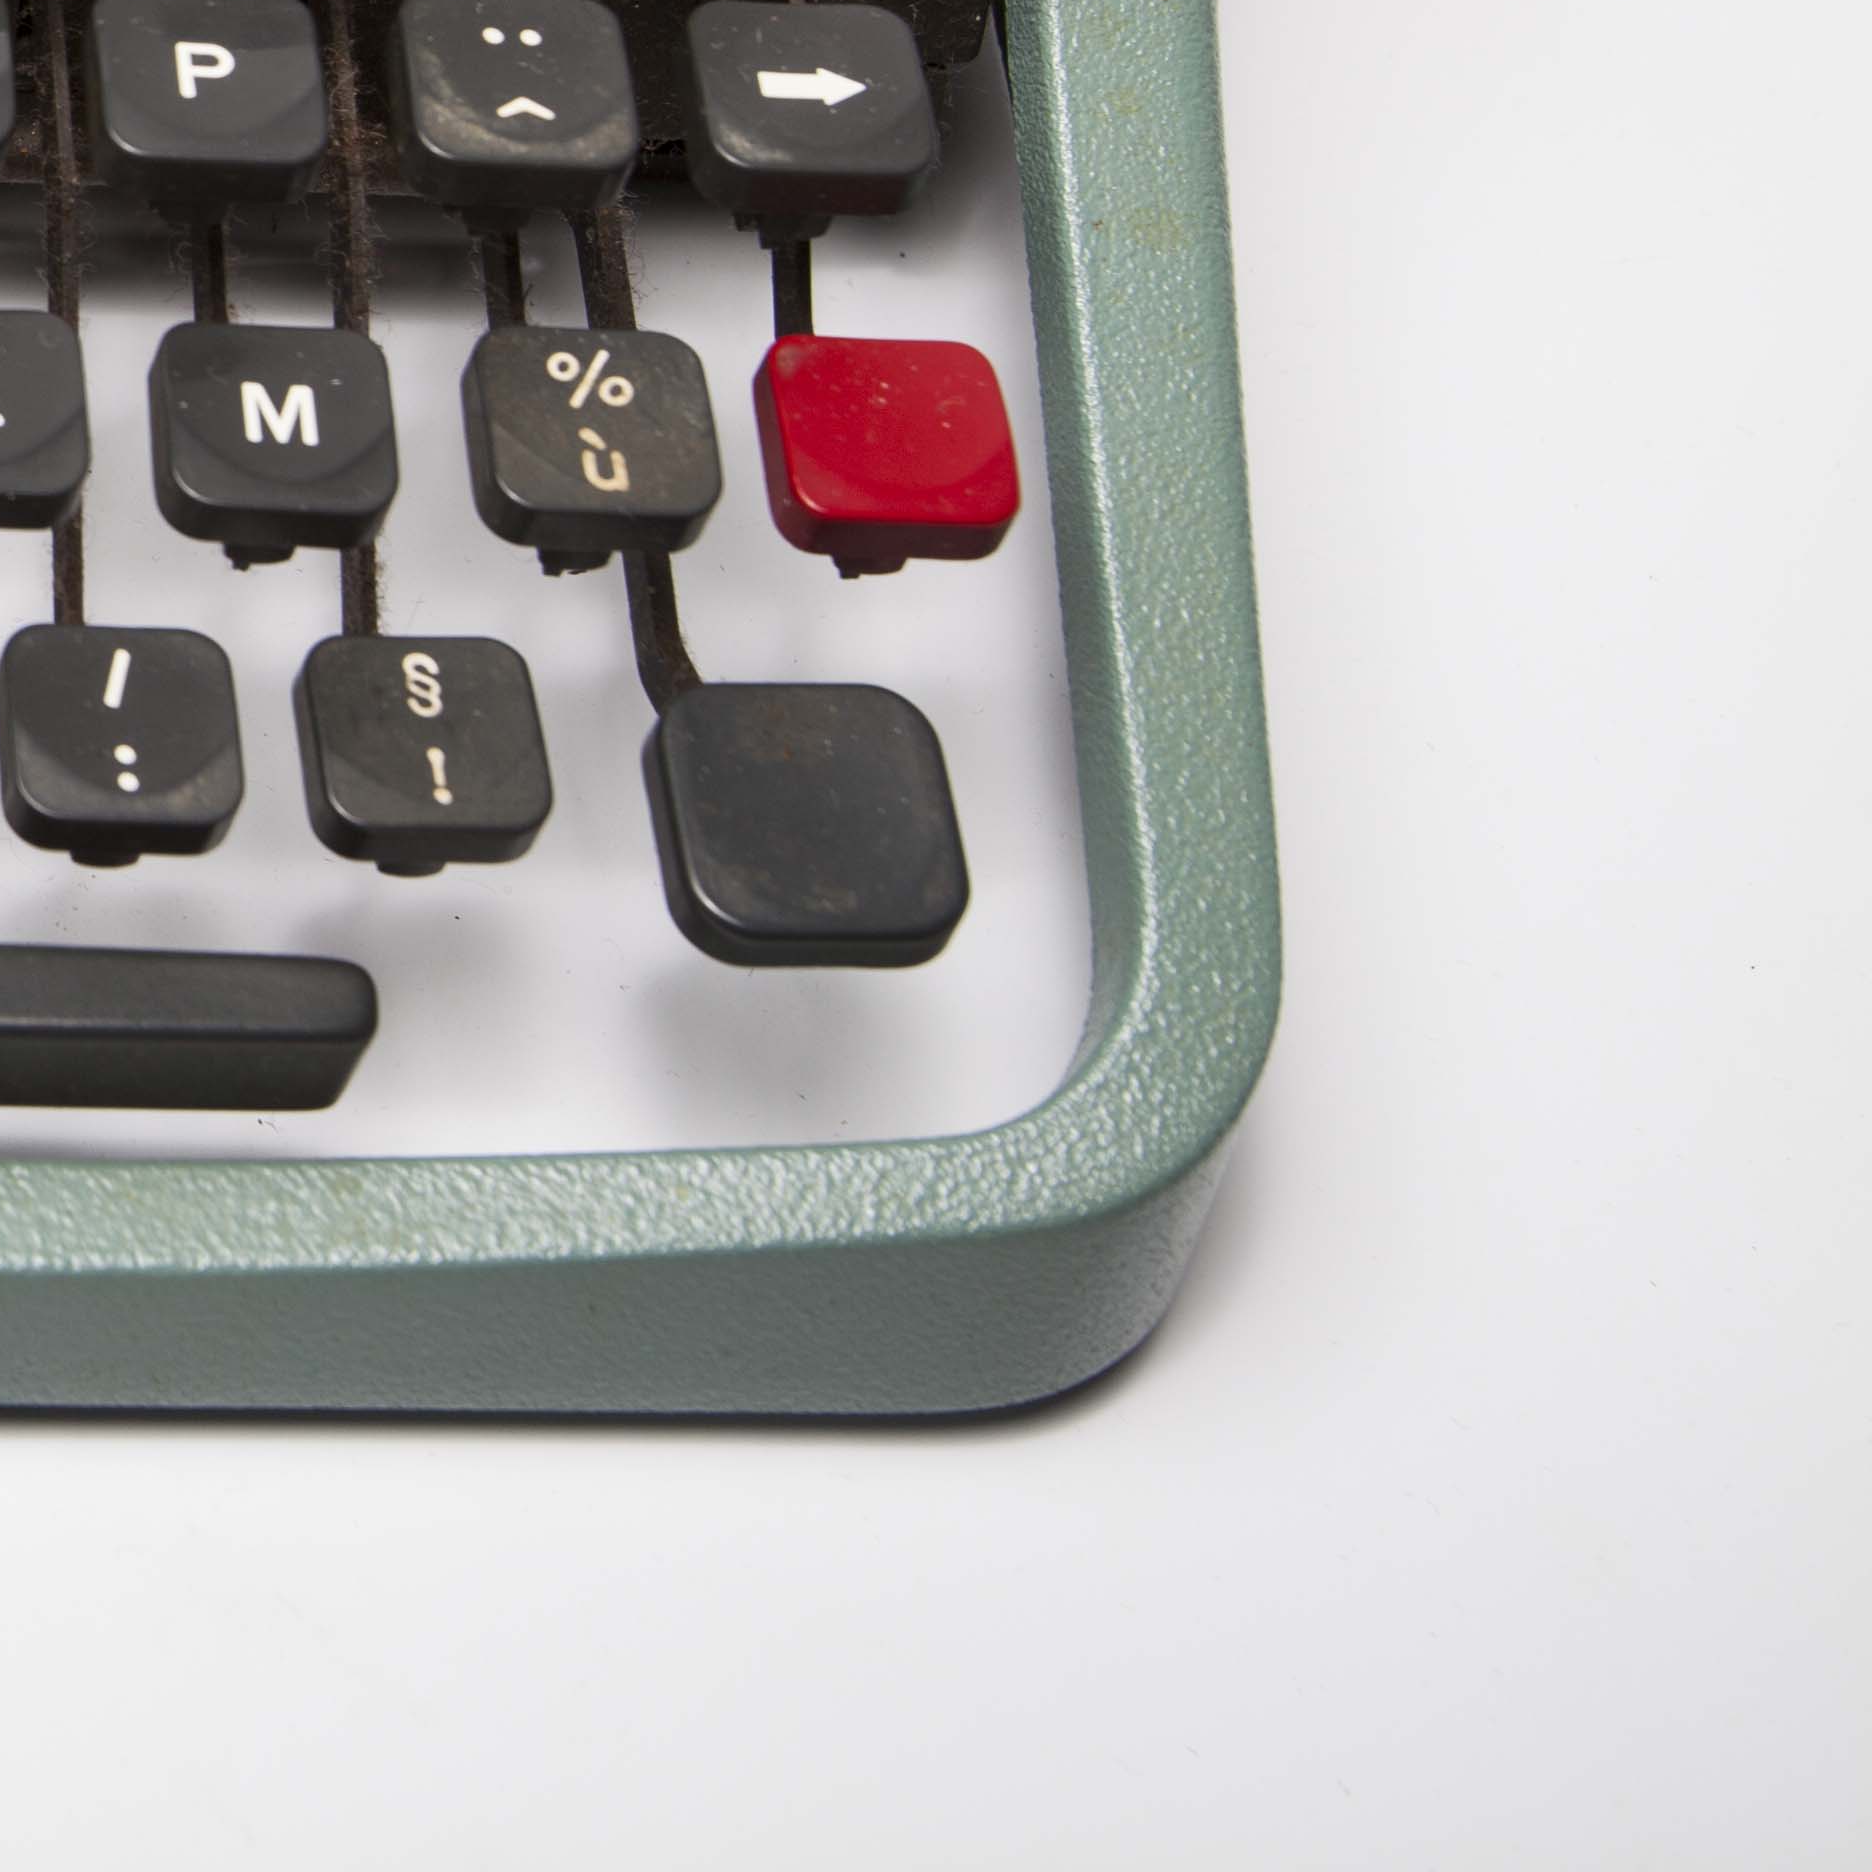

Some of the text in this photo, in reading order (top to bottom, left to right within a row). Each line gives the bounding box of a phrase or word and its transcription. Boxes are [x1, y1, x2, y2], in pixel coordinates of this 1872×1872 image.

[174, 41, 236, 99] P
[546, 349, 634, 409] %
[240, 381, 319, 447] M
